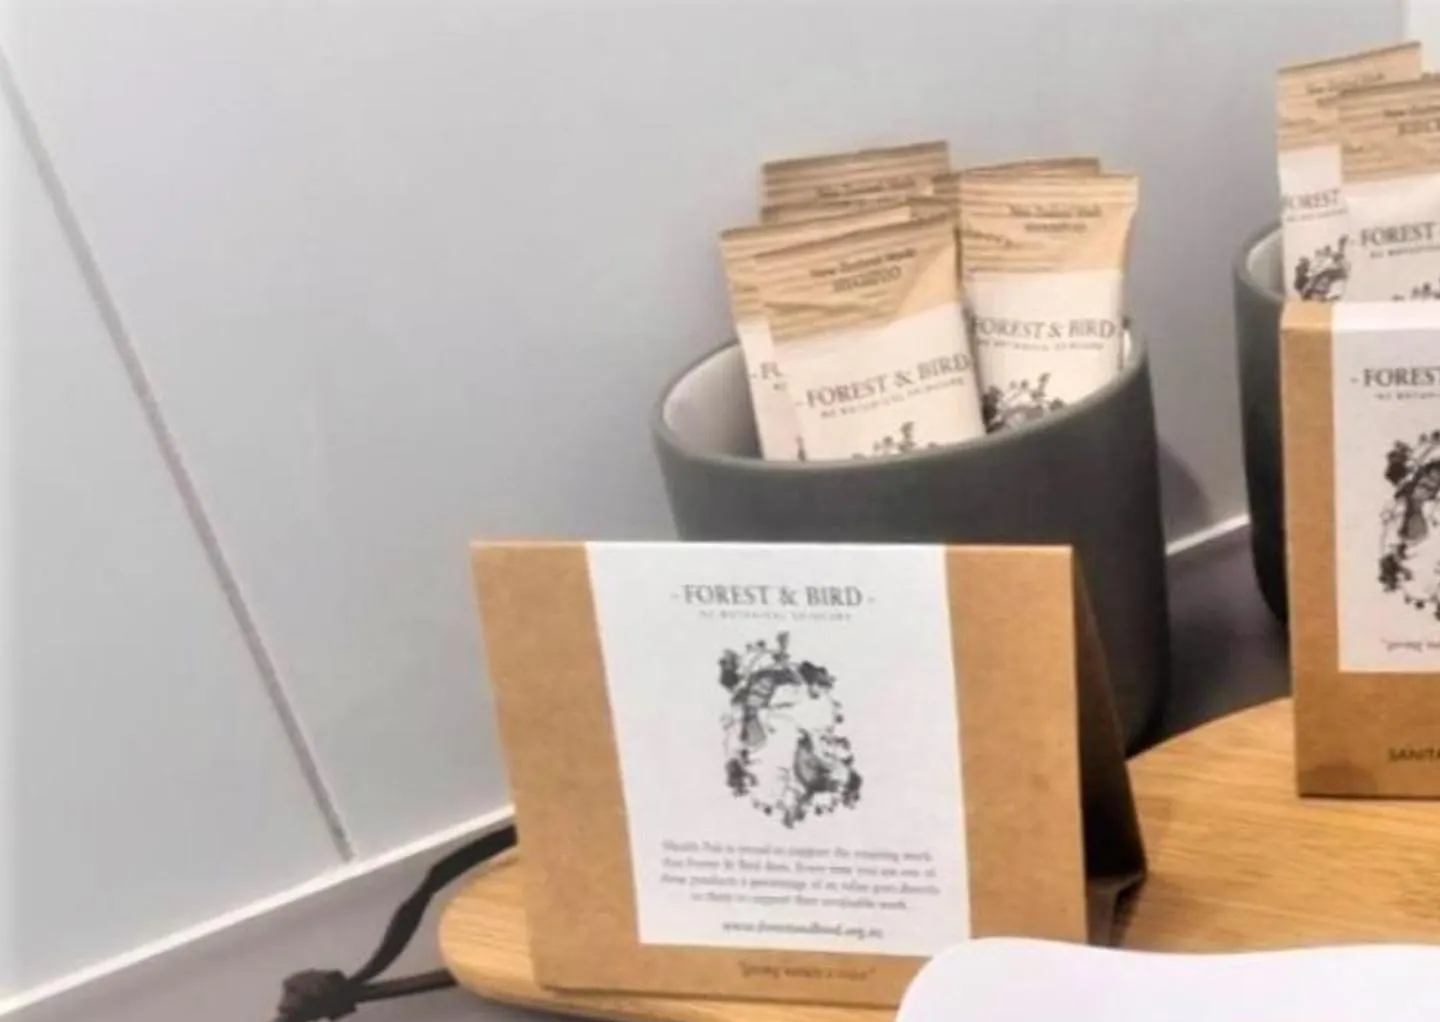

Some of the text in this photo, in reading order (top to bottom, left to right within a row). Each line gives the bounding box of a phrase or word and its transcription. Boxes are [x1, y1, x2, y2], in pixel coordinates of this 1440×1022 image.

[1360, 222, 1437, 246] FOREST
[1049, 320, 1063, 339] &
[1068, 318, 1118, 339] BIRD
[804, 373, 888, 410] FOREST
[892, 369, 914, 389] &
[916, 352, 975, 381] BIRD
[682, 584, 864, 607] FOREST & BIRD
